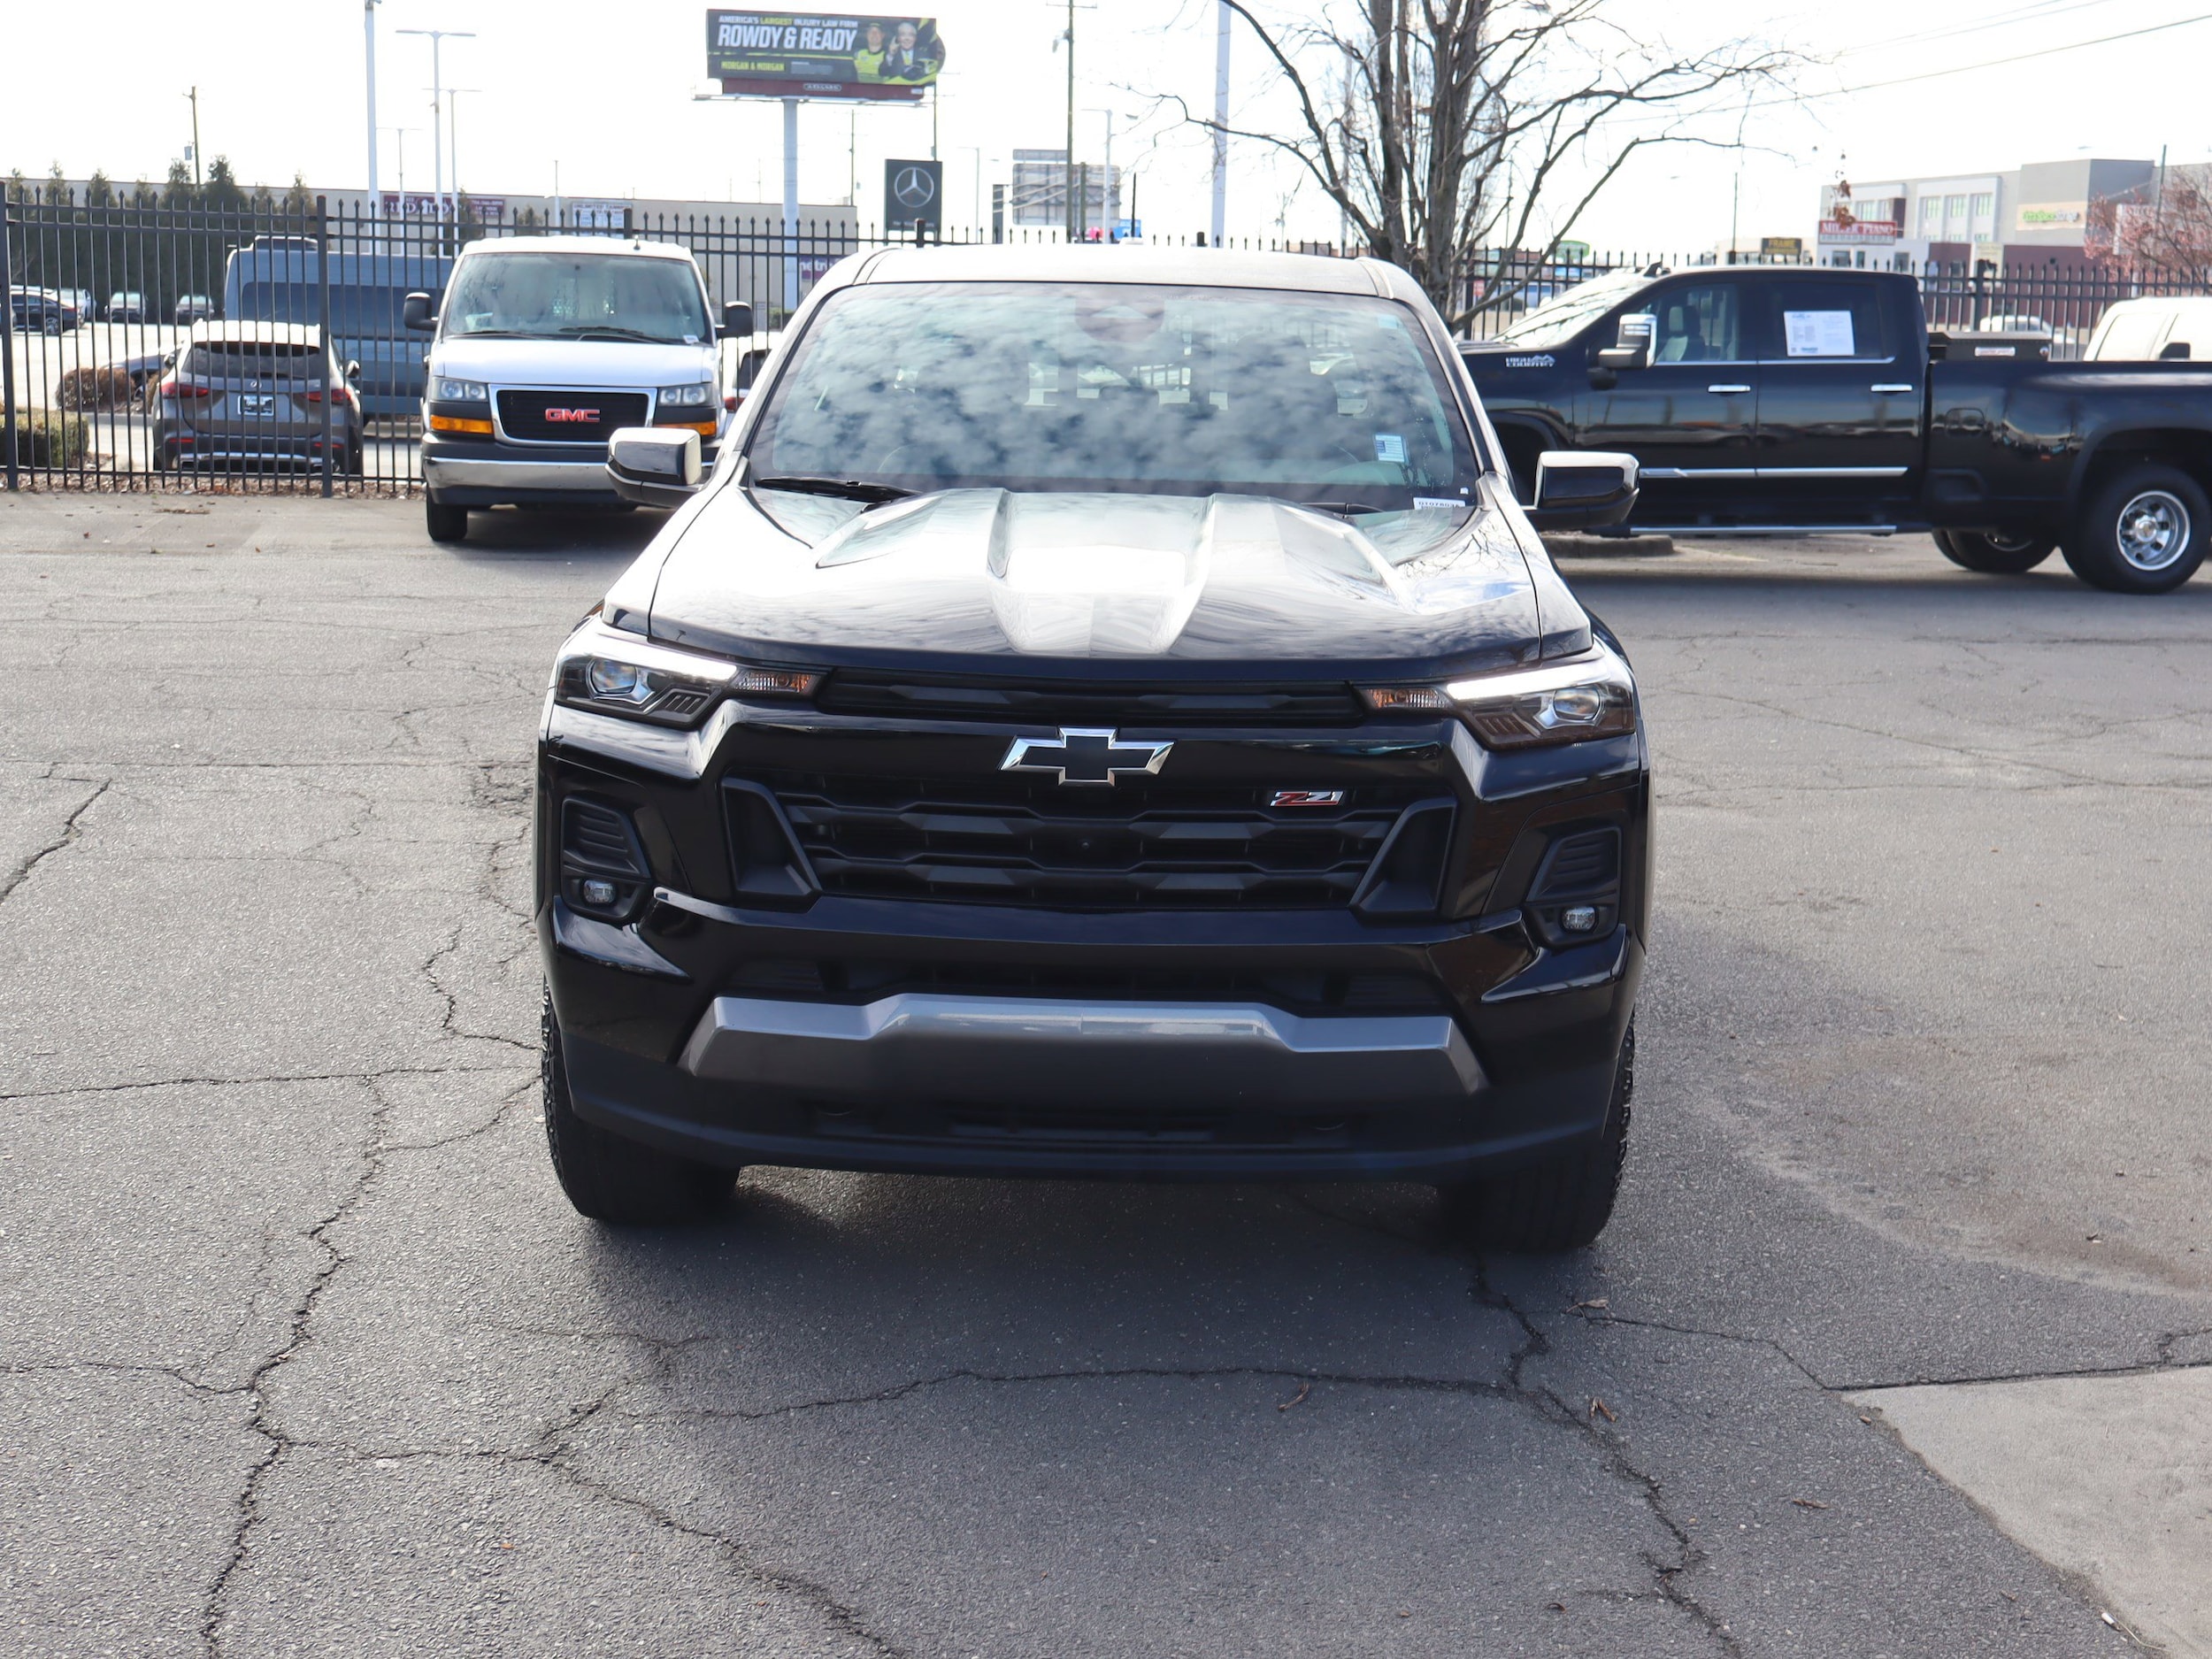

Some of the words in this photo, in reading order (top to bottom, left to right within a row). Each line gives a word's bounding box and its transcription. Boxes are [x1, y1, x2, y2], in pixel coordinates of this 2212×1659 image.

[718, 15, 758, 24] AMERICA'S
[760, 17, 793, 26] LARGEST
[794, 18, 820, 27] INJURY
[822, 19, 838, 28] LAW
[839, 19, 858, 29] FIRM
[718, 24, 785, 49] ROWDY
[784, 26, 797, 50] &
[799, 27, 857, 51] READY
[721, 60, 749, 70] MORGAN
[750, 62, 756, 71] &
[757, 62, 785, 72] MORGAN
[1863, 222, 1895, 234] PIANO
[545, 408, 601, 423] GMC
[1270, 790, 1344, 807] Z71
